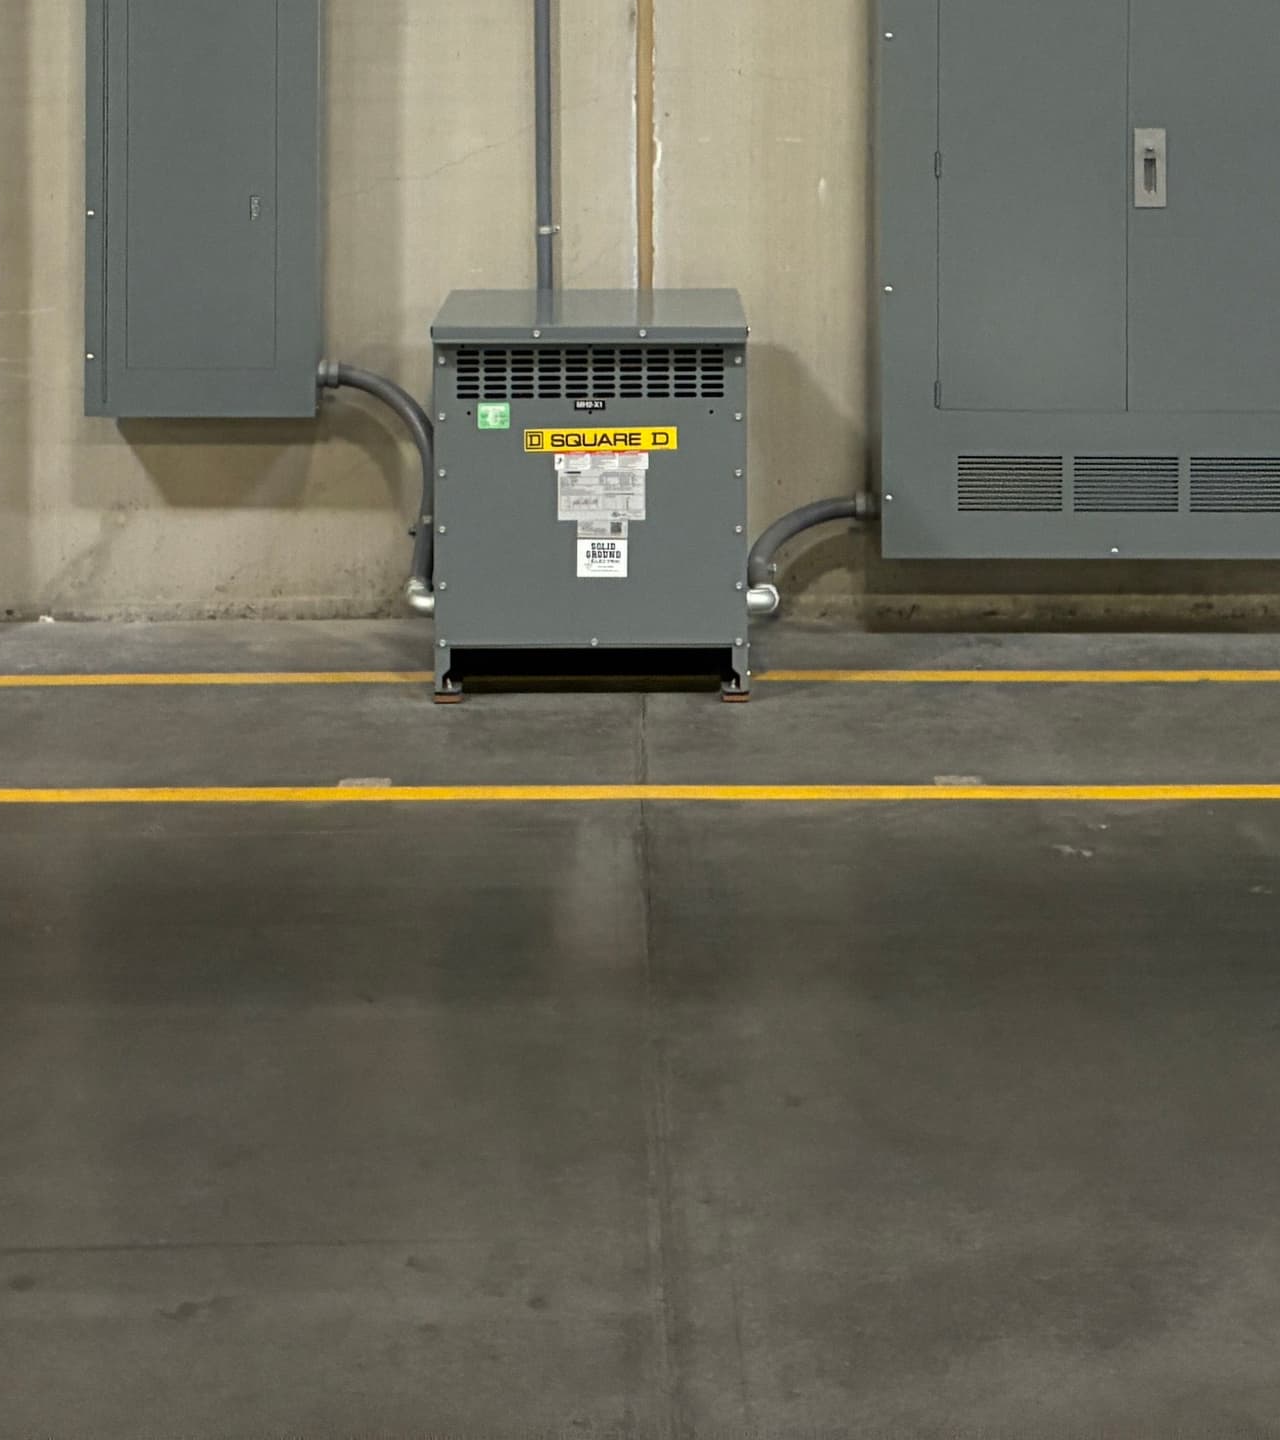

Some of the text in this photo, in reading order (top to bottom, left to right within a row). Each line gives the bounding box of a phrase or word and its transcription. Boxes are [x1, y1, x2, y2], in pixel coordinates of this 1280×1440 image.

[551, 433, 641, 447] SQUARE
[651, 432, 669, 446] D
[591, 542, 616, 550] SOLID
[586, 550, 622, 559] GROUND
